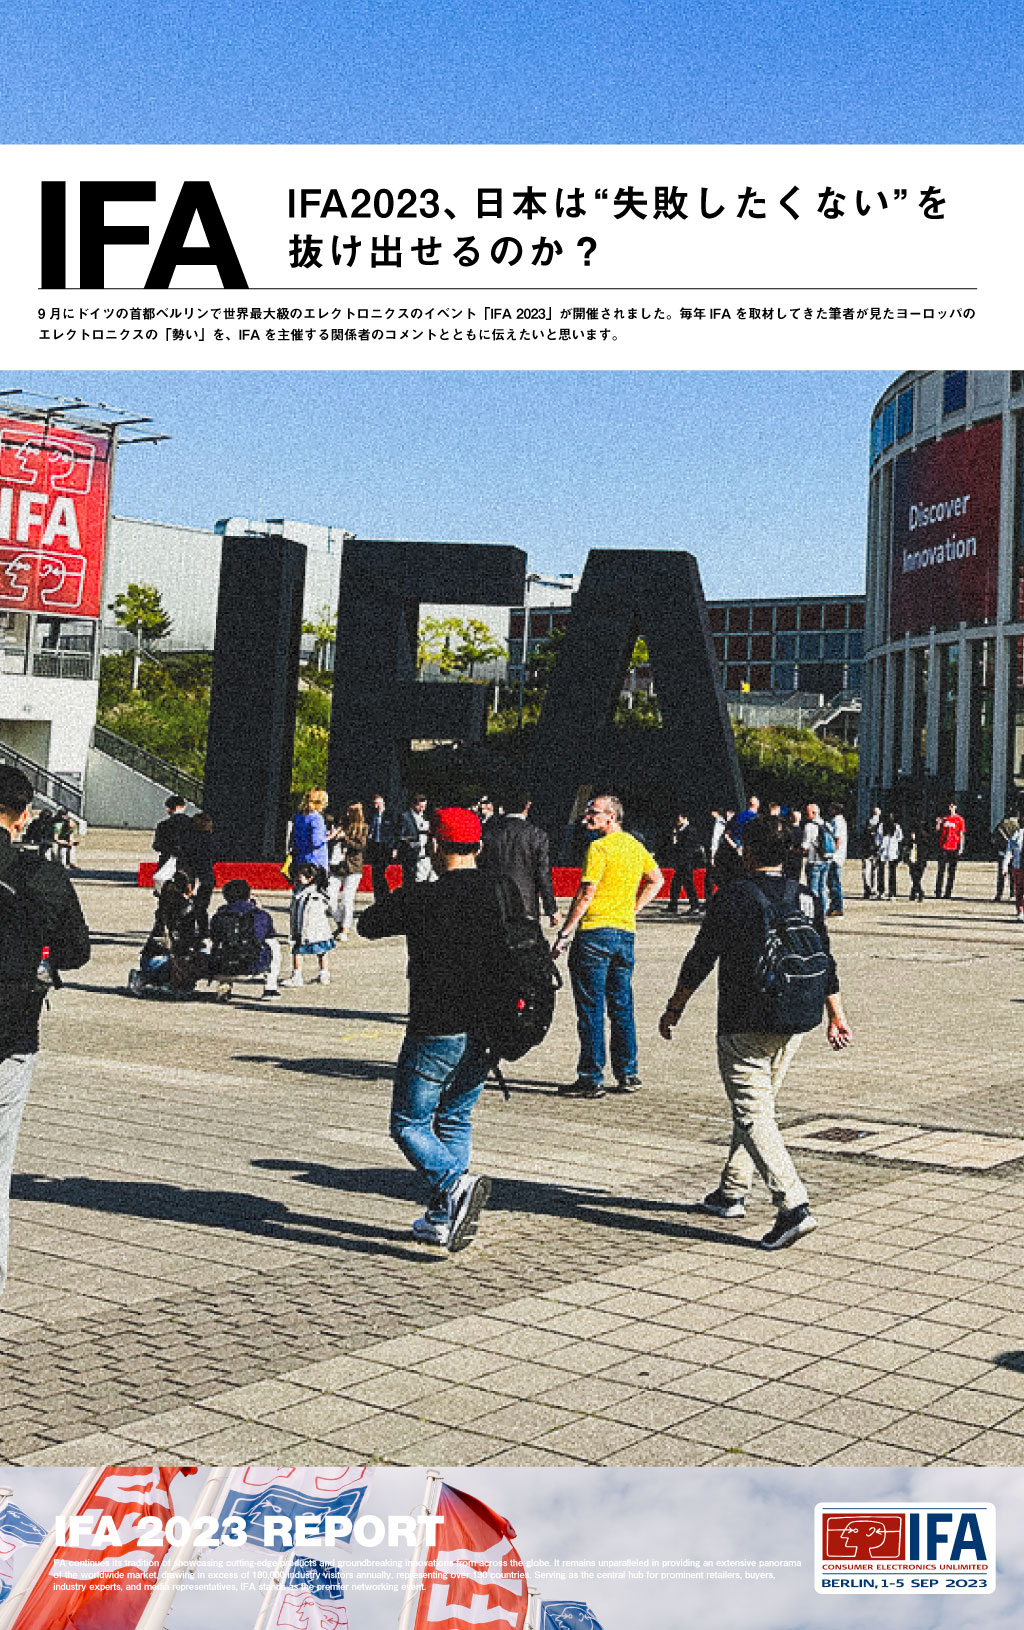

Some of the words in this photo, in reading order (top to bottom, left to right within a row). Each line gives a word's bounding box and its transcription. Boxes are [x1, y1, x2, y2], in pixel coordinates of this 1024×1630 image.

[0, 487, 81, 550] IFA
[908, 494, 971, 532] Discover
[902, 533, 977, 572] Innovation
